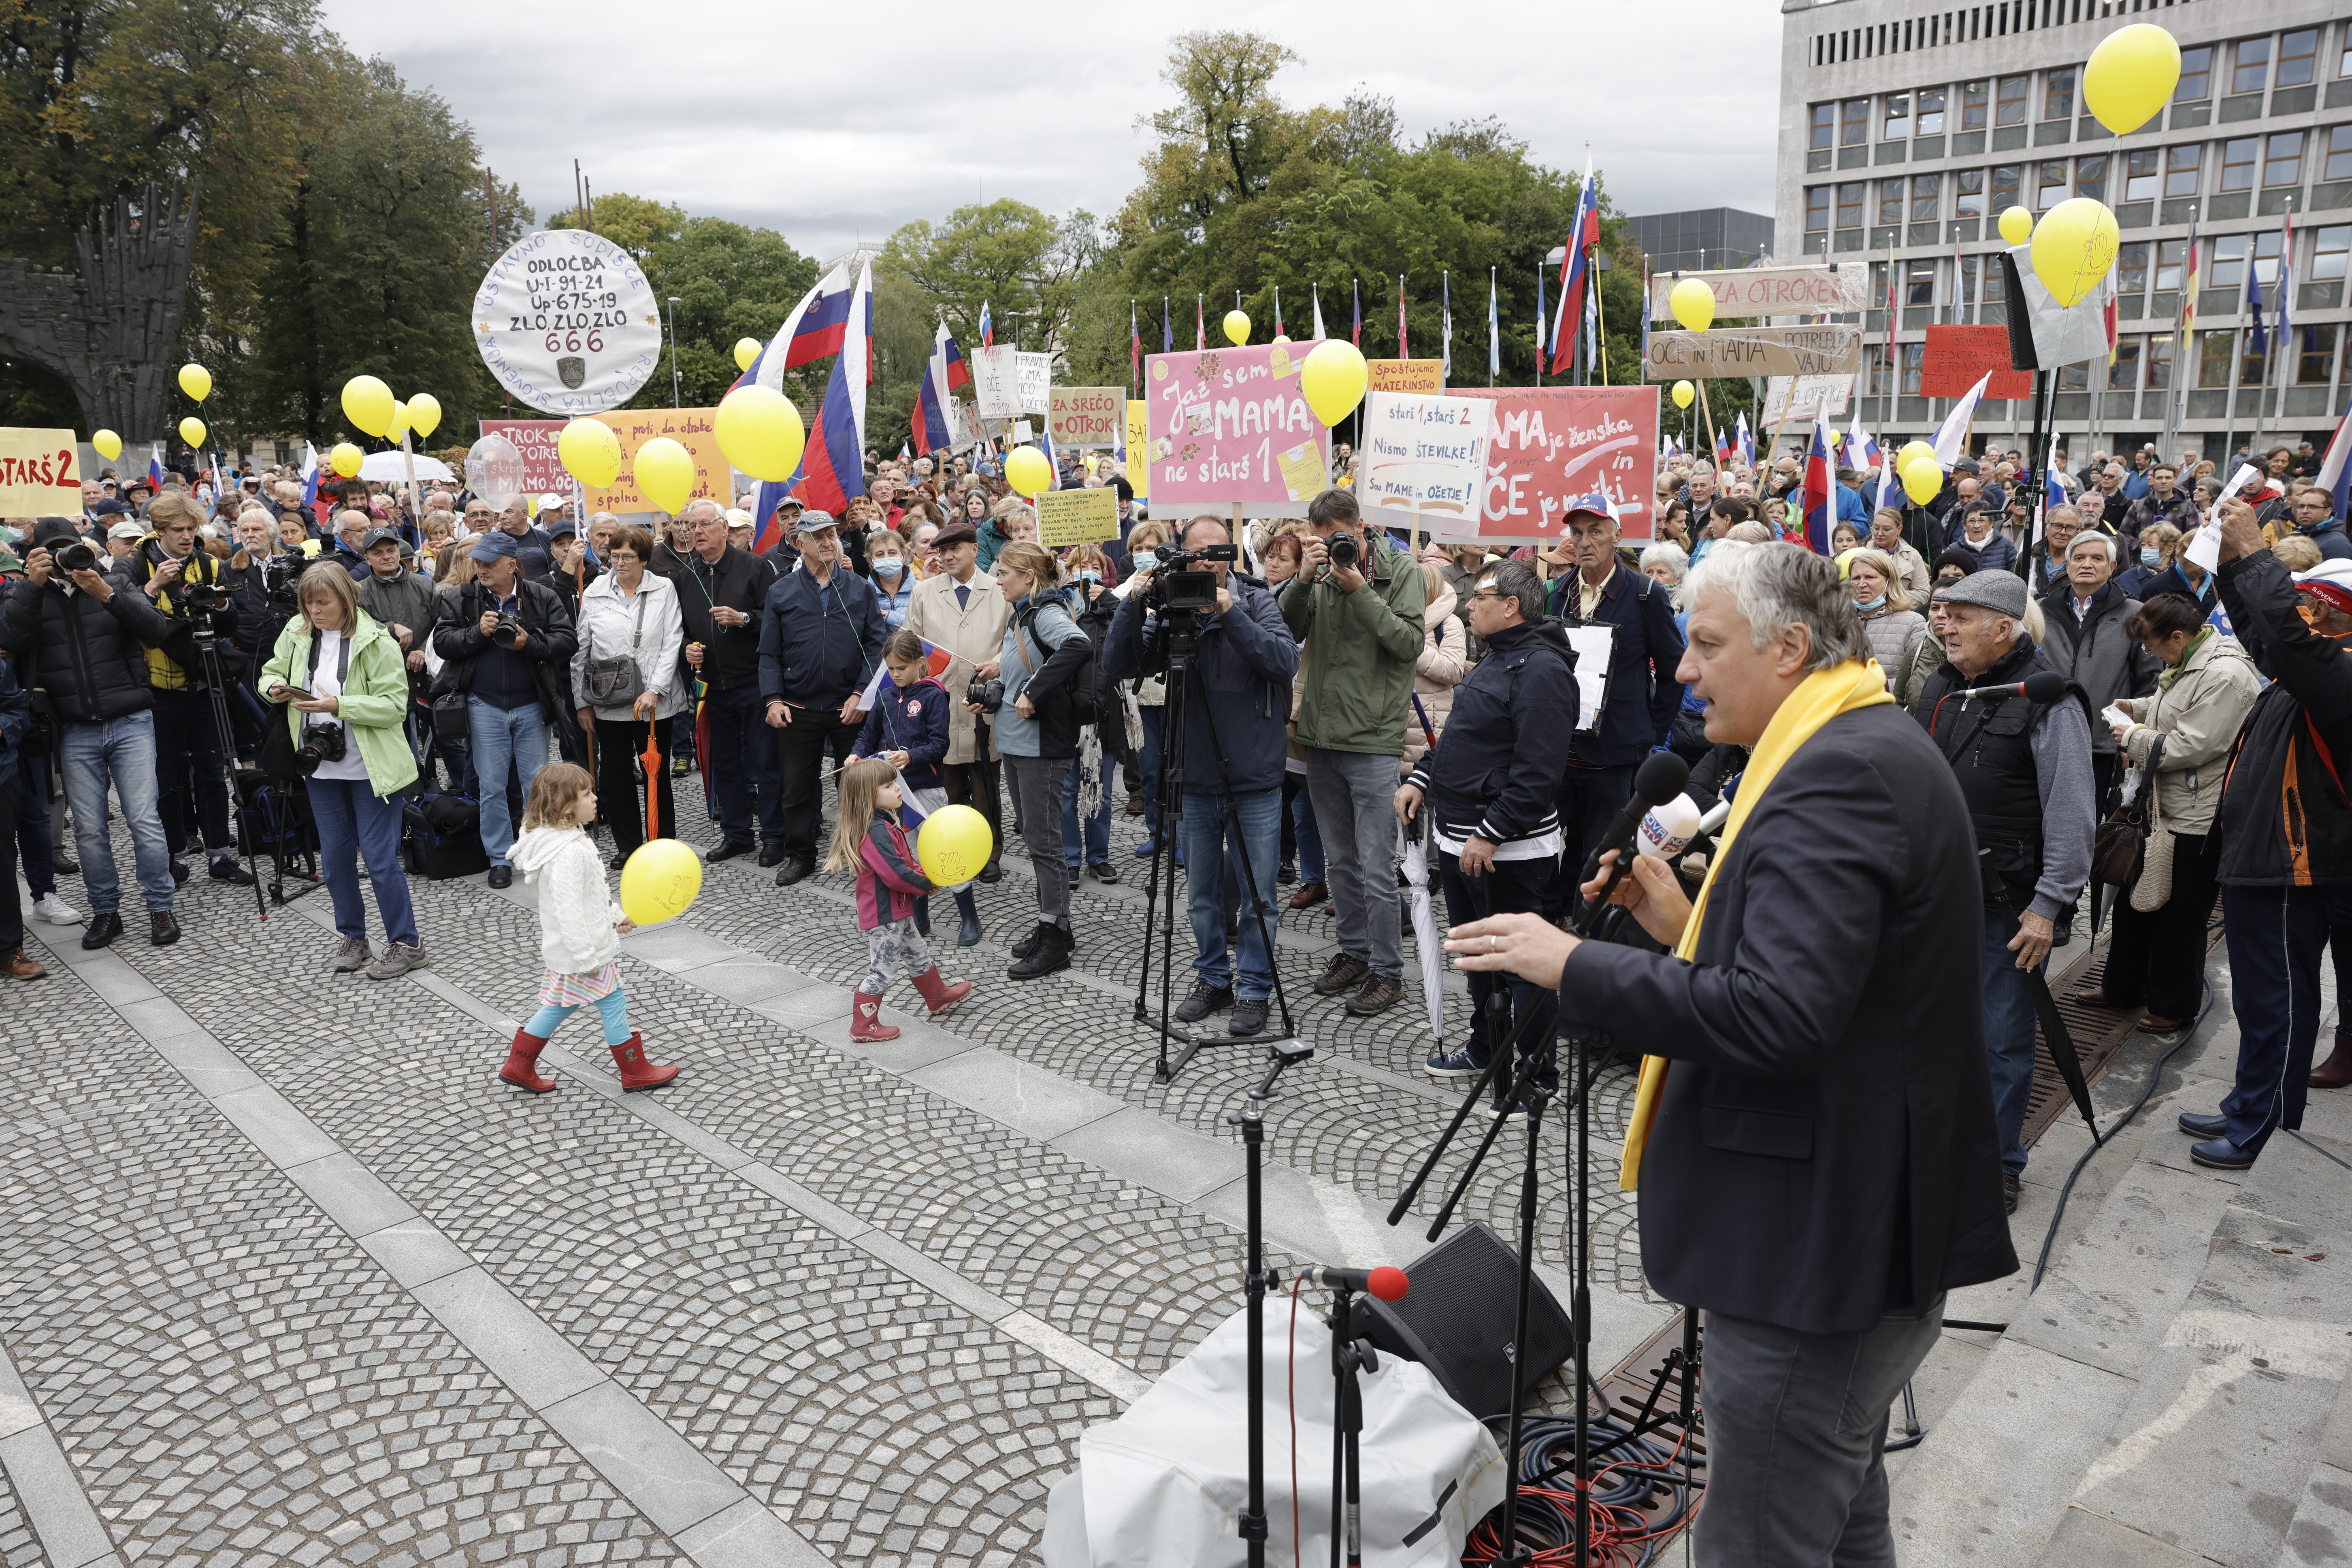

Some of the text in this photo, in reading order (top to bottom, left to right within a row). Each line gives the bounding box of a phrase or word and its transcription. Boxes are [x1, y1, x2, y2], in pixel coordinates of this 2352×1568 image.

[483, 236, 545, 306] USTAVNO
[528, 255, 605, 273] ODLOČBA
[1711, 281, 1738, 304] ZA
[1748, 277, 1828, 303] OTROKE
[1969, 327, 1990, 336] PAROV
[981, 347, 1003, 362] MAMA
[1651, 338, 1685, 365] OČE
[1711, 335, 1766, 362] MAMA
[1930, 351, 1978, 360] 255 DIKTIRA
[1021, 355, 1051, 369] PRAVICA
[1376, 361, 1434, 380] Spoštujemo
[1794, 352, 1833, 373] VAJU
[1934, 362, 2013, 372] JE TO NORMALN
[484, 336, 651, 409] SLOVENIJA REPUBLIKA
[1026, 369, 1041, 381] IMA
[986, 374, 1001, 392] OČE
[1372, 379, 1435, 391] MATERINSTVO
[1924, 373, 1951, 395] TEGA
[1052, 393, 1114, 412] ZA SREČO
[1163, 365, 1268, 435] Jaz sem
[1804, 382, 1848, 405] OTROKE
[989, 403, 1014, 417] OTROK
[1027, 397, 1049, 411] OČETA
[1214, 394, 1314, 441] MAMA,
[1389, 403, 1415, 420] starš
[1459, 407, 1471, 425] 2
[662, 419, 675, 433] da
[680, 417, 713, 434] otroke
[1065, 415, 1113, 434] OTROK
[490, 427, 548, 447] OTROK
[1374, 437, 1407, 456] Nismo
[1545, 432, 1564, 462] je
[1568, 412, 1633, 448] ženska
[56, 450, 81, 488] 2
[537, 464, 544, 473] in
[1131, 450, 1141, 471] IN
[1165, 465, 1188, 483] ne
[1198, 445, 1250, 483] starš
[1257, 437, 1270, 483] 1
[1512, 456, 1542, 467] #vzgoja
[1612, 451, 1634, 470] in
[698, 465, 707, 477] in
[499, 474, 556, 492] MAMO in
[1370, 477, 1382, 491] Smo
[1385, 481, 1413, 497] MAME
[1416, 488, 1423, 499] in
[597, 490, 638, 510] spolno
[1537, 490, 1558, 528] je
[1321, 571, 1331, 581] anon
[2312, 586, 2340, 607] SLOVENIJA
[1640, 820, 1660, 843] 4TV
[1645, 812, 1667, 839] NOVA
[936, 873, 952, 881] OTROKE
